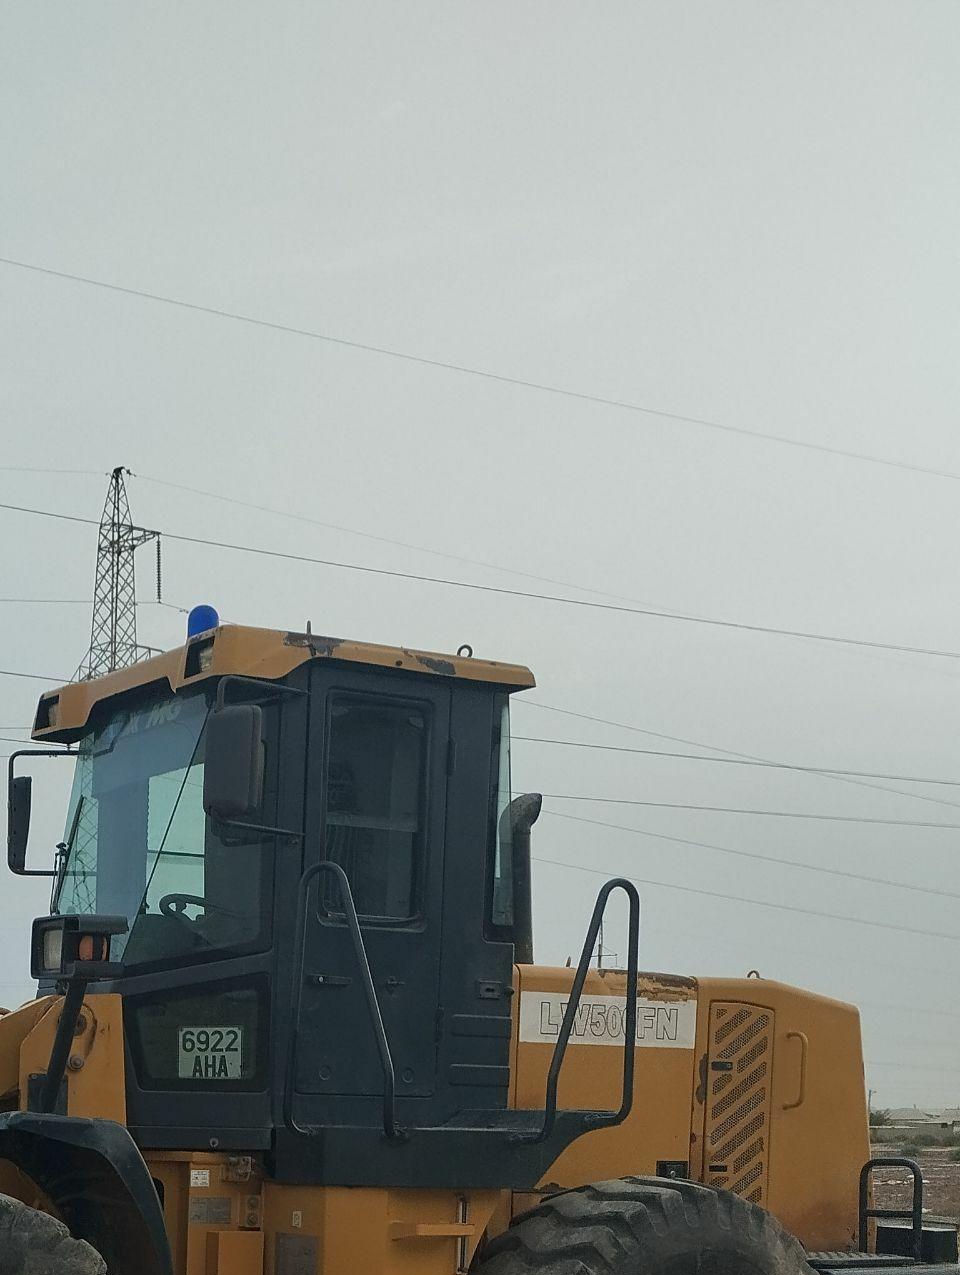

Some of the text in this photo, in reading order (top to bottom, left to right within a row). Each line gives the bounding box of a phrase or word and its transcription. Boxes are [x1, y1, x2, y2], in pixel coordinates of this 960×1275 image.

[540, 1002, 678, 1040] LW50FN
[182, 1030, 238, 1052] 6922
[192, 1055, 228, 1077] AHA
